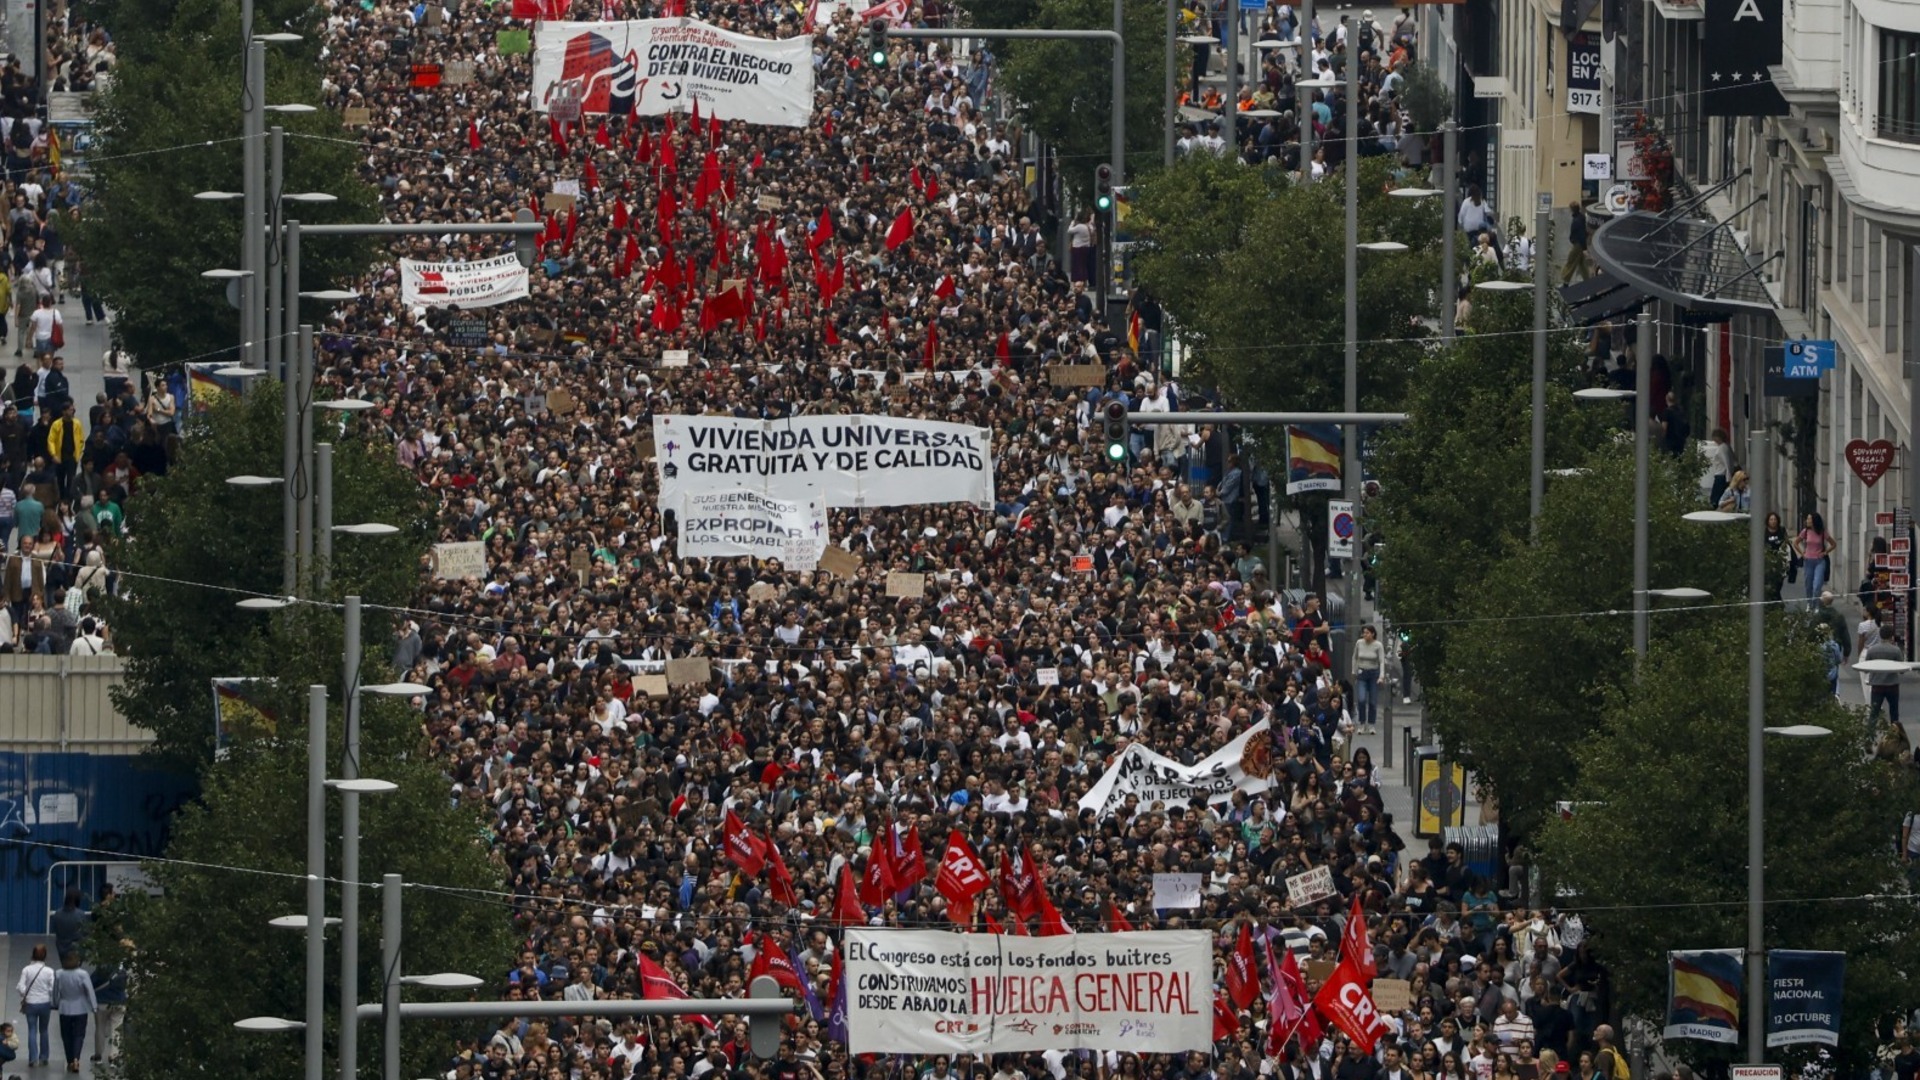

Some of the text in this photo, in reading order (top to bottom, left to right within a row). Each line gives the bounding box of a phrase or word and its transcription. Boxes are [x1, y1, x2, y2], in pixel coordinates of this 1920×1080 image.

[1733, 0, 1763, 21] A
[648, 44, 793, 76] CONTRA EL NEGOCIO
[1572, 52, 1601, 66] LOC
[648, 60, 759, 85] DE LA VIVIENDA
[1572, 67, 1591, 80] EN
[1571, 92, 1592, 107] 917
[413, 255, 516, 273] UNIVERSITARIO
[449, 283, 494, 297] PÚBLICA
[1803, 344, 1819, 364] S
[1790, 365, 1819, 377] ATM
[688, 425, 980, 452] VIVIENDA UNIVERSAL
[688, 449, 984, 476] GRATUITA Y DE CALIDAD
[1855, 456, 1886, 464] REGALO
[1861, 464, 1879, 472] GIFT
[692, 492, 798, 513] SUS BENEFICIOS
[702, 504, 783, 520] NUESTRA MISRIA
[686, 518, 804, 539] EXPROPIAR
[692, 534, 720, 546] LOS
[723, 534, 785, 548] CULPABL
[1142, 790, 1155, 801] NI
[945, 846, 986, 885] CRT
[849, 942, 867, 961] El
[867, 942, 936, 968] Congreso
[940, 951, 971, 968] está
[974, 954, 1003, 967] con
[1036, 950, 1098, 969] fondos
[1106, 948, 1172, 967] buitres
[858, 973, 968, 995] CONSTRUYAMOS
[1773, 978, 1804, 988] FIESTA
[970, 970, 1199, 1016] HUELGA GENERAL
[1773, 989, 1825, 1001] NACIONAL
[859, 994, 968, 1015] DESDE ABAJO LA
[1340, 982, 1385, 1036] CRT
[934, 1020, 964, 1033] CRT
[1774, 1012, 1832, 1026] 12 OCTUBRE
[1688, 1027, 1722, 1039] MADRID
[1734, 1068, 1779, 1077] PRECAUCIÓN
